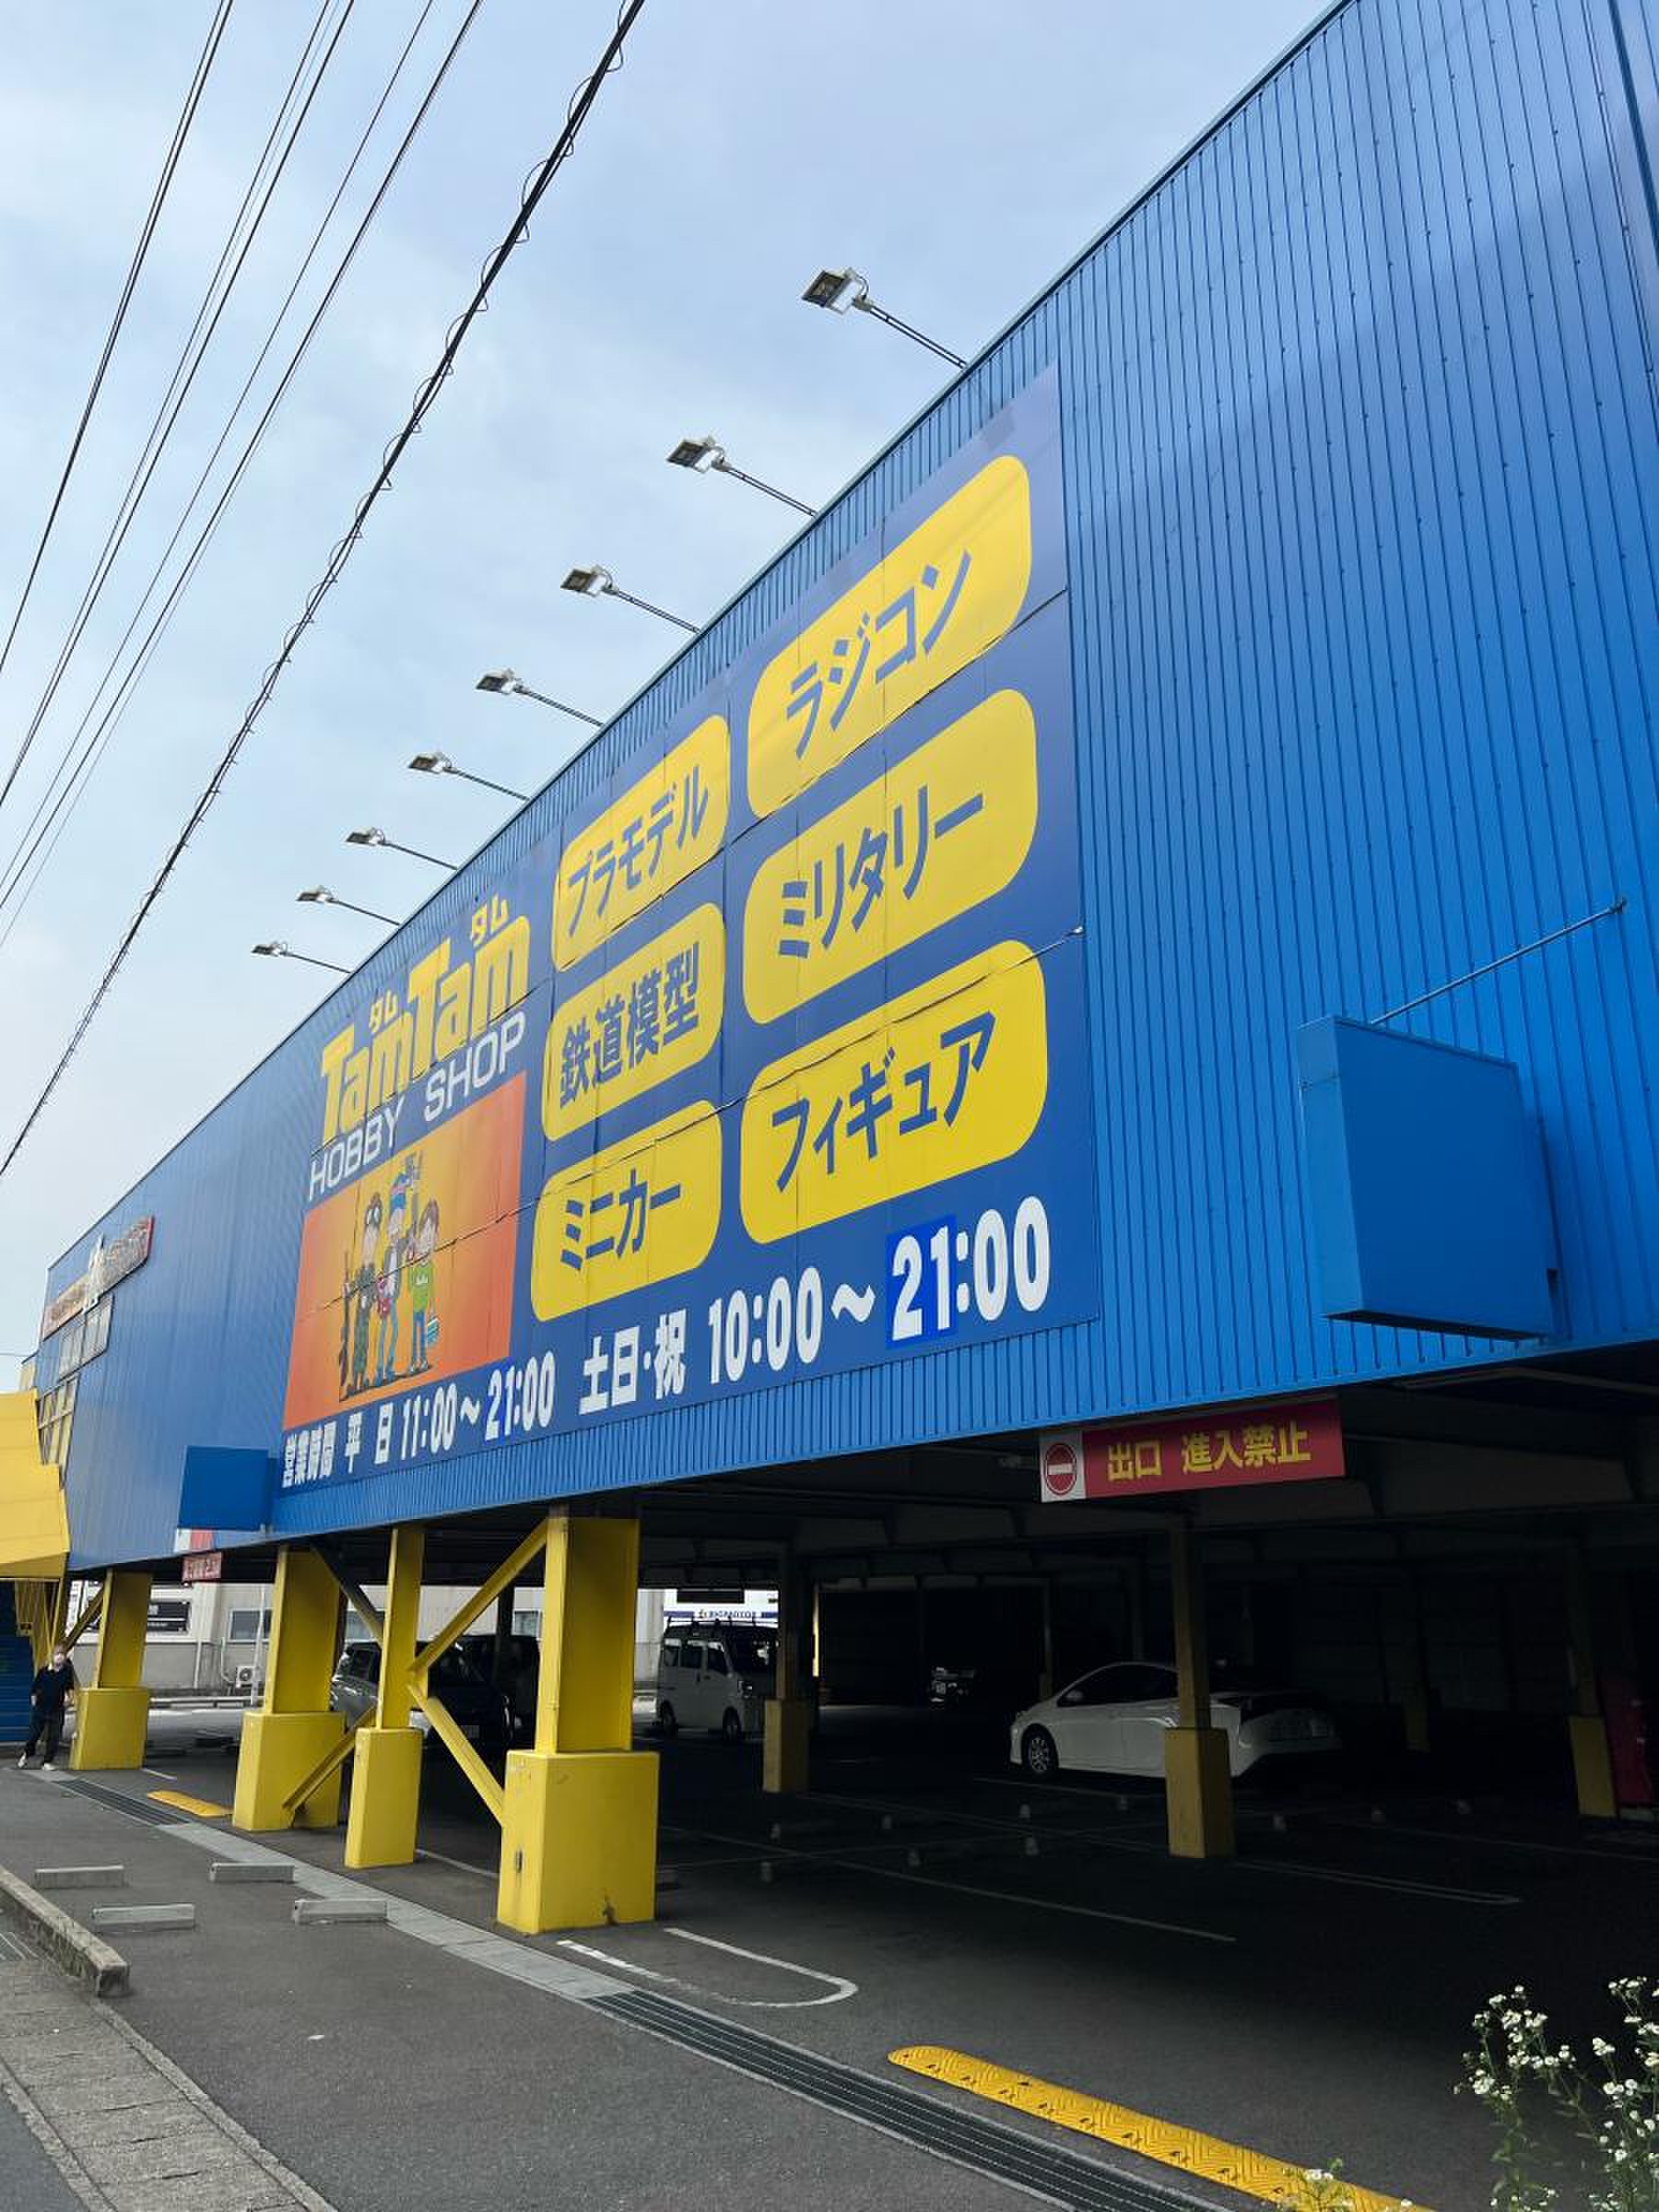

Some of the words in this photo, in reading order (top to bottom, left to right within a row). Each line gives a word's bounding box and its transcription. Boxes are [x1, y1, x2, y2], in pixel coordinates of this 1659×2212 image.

[786, 550, 971, 759] ラジコン
[568, 765, 708, 936] プラモデル
[778, 785, 983, 960] ミリタリー
[309, 1096, 405, 1201] HOBBY
[425, 1012, 525, 1122] SHOP
[559, 941, 700, 1109] 鉄道模型
[771, 1011, 996, 1193] フィギュア
[560, 1168, 681, 1272] ミニカー
[1108, 1441, 1163, 1482] 出口
[1181, 1419, 1312, 1474] 進入禁止
